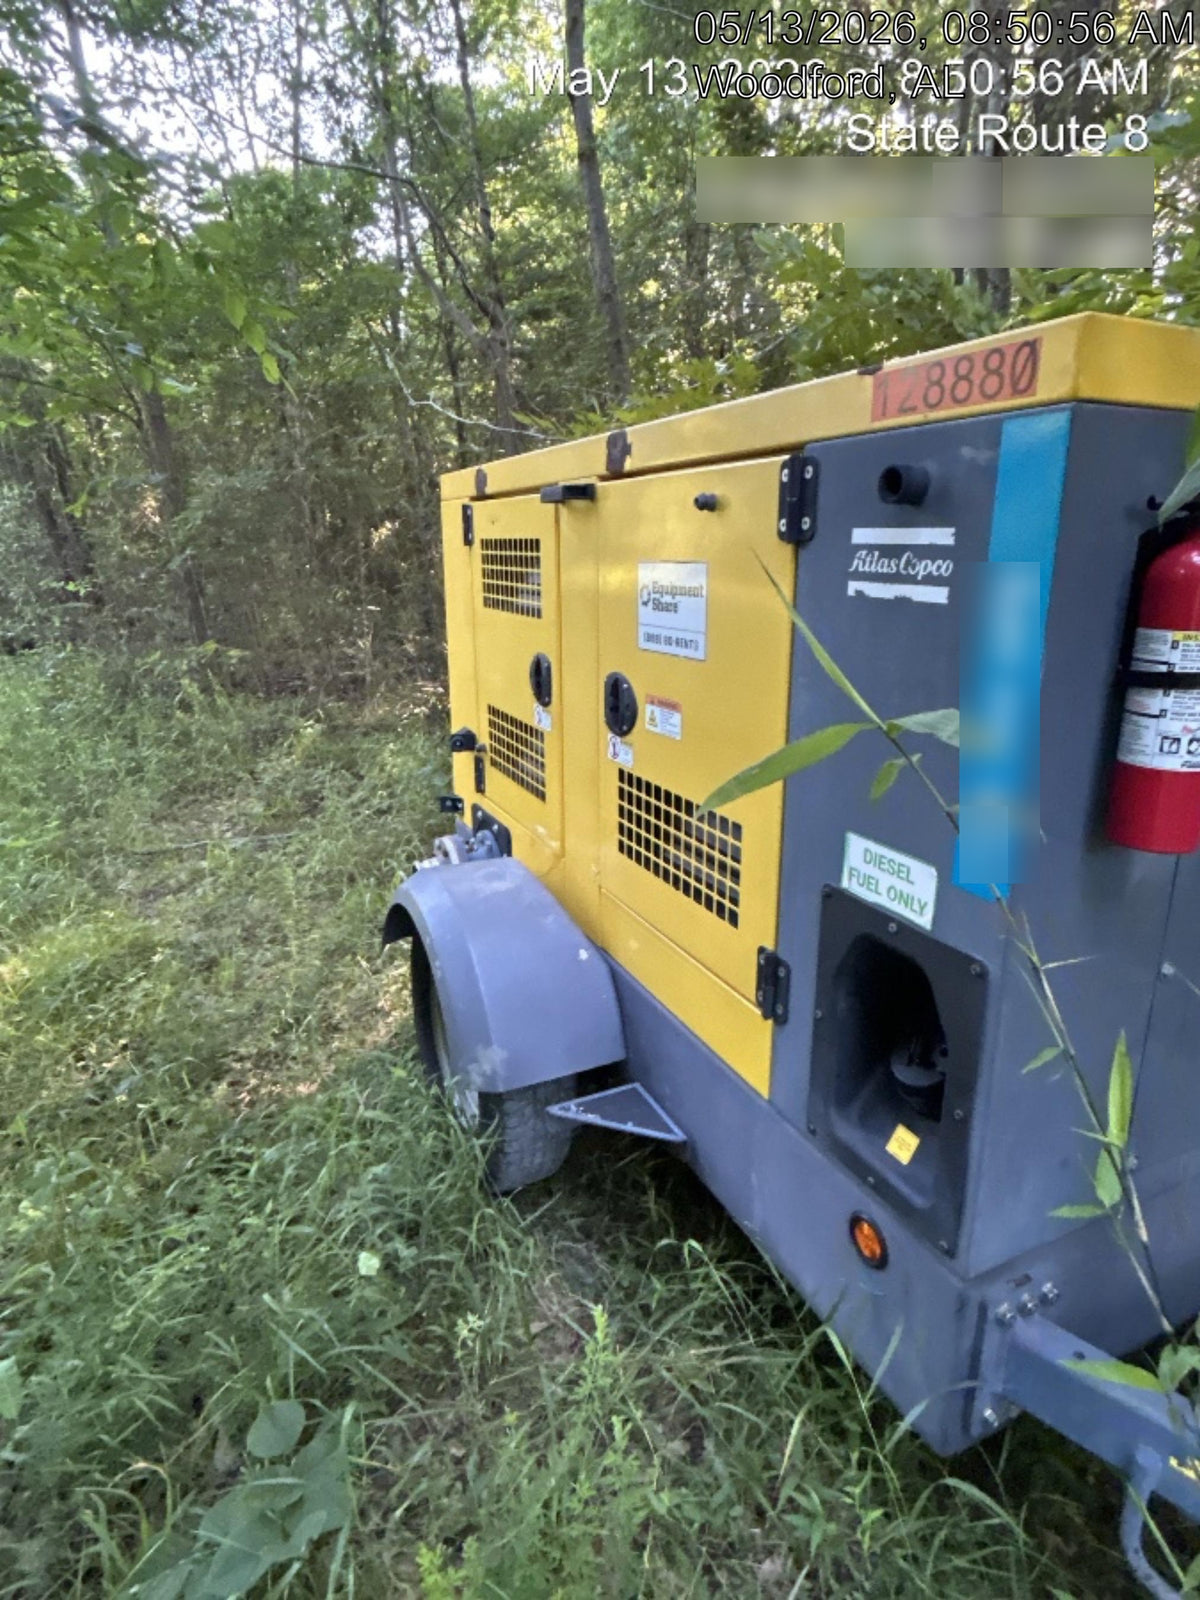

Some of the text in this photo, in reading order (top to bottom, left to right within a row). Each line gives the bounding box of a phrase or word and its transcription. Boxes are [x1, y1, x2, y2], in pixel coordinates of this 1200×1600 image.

[877, 338, 1039, 418] 128880
[848, 549, 954, 581] Atlas Copco
[652, 581, 704, 600] Equipment
[652, 597, 679, 615] Share
[863, 847, 915, 886] DIESEL
[848, 865, 928, 917] FUEL ONLY
